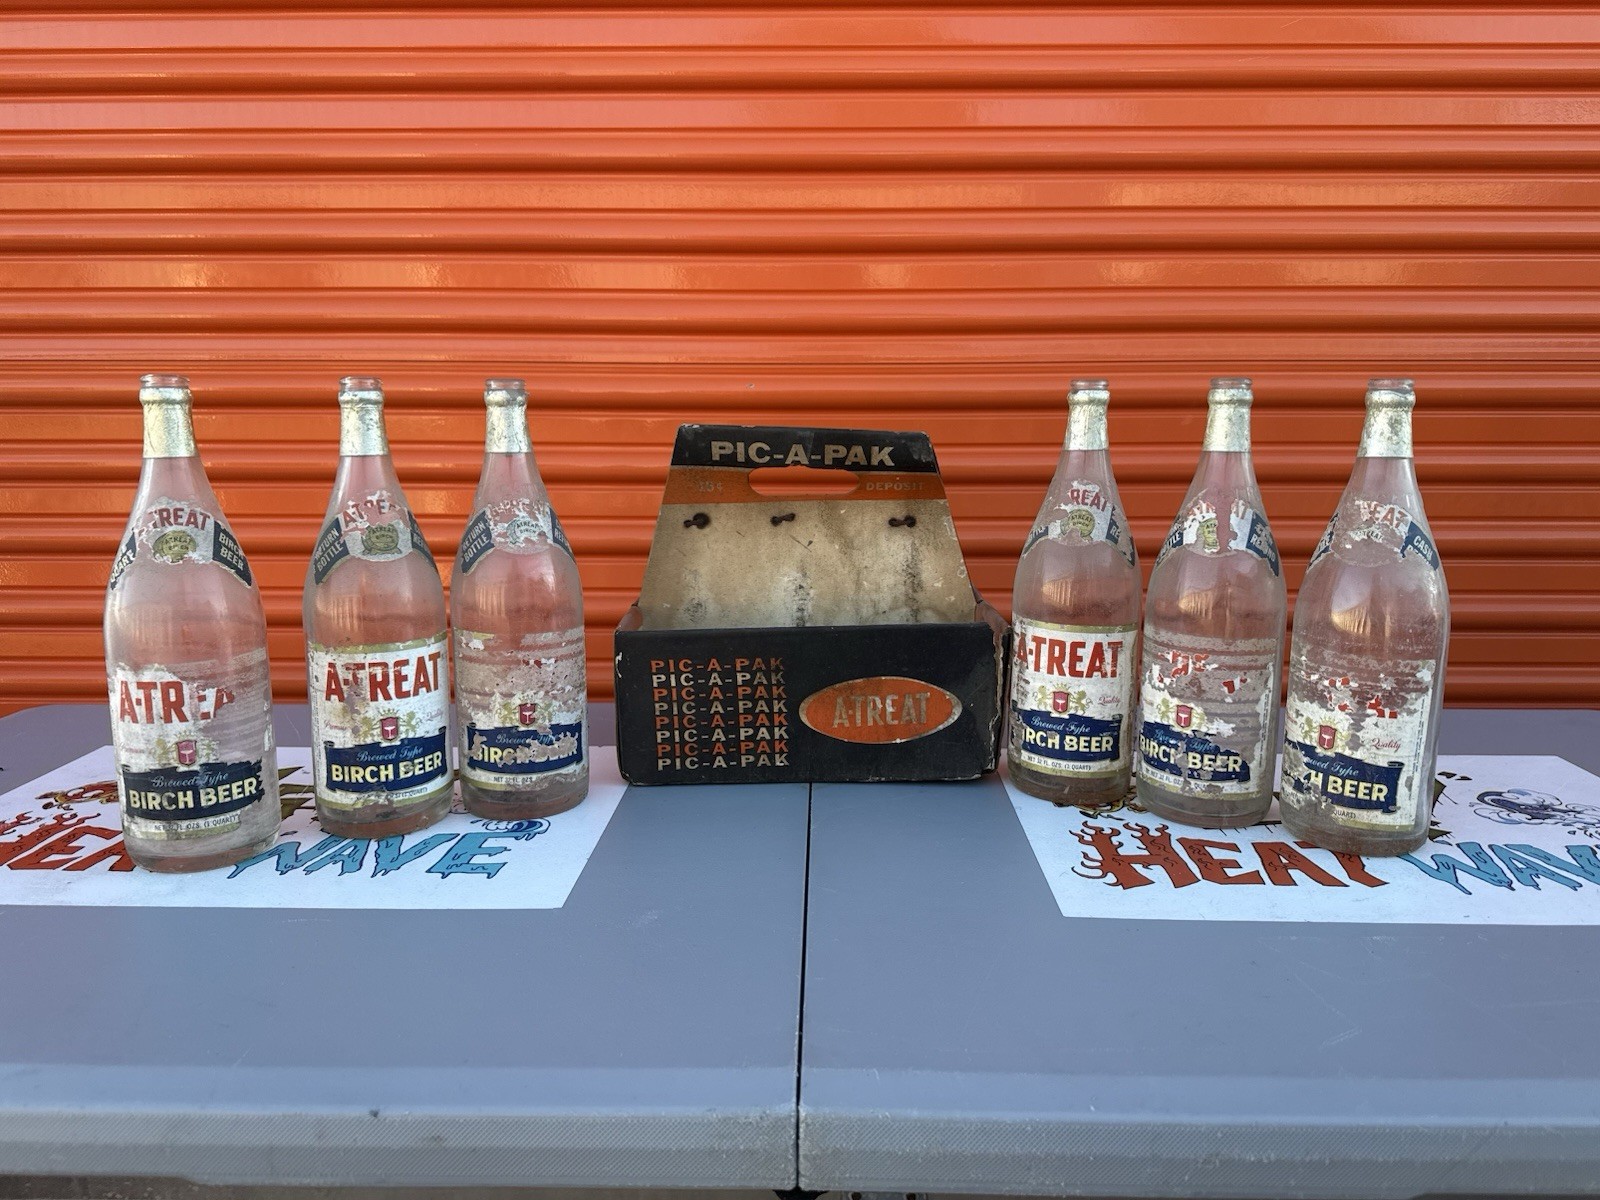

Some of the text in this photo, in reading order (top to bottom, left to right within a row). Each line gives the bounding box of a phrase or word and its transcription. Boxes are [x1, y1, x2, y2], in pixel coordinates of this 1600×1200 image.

[710, 440, 895, 467] PIC-A-PAK
[865, 481, 925, 491] DEPOSIT
[462, 520, 486, 551] RETURN
[463, 533, 490, 562] BOTTLE
[1413, 535, 1434, 560] CASH
[219, 545, 245, 571] BEER
[650, 658, 785, 672] PIC-A-PAK
[652, 671, 786, 687] PIC-A-PAK
[652, 686, 787, 701] PIC-A-PAK
[654, 700, 788, 715] PIC-A-PAK
[655, 714, 788, 729] PIC-A-PAK
[1030, 715, 1091, 735] Brewed Type
[656, 728, 789, 743] PIC-A-PAK
[1064, 734, 1114, 752] BEER
[356, 746, 424, 762] Brewed Type
[657, 742, 789, 757] PIC-A-PAK
[1372, 737, 1402, 753] Quality
[331, 751, 443, 784] BIRCH BEER
[657, 753, 789, 771] PIC-A-PAK
[1188, 751, 1242, 772] BEER
[1331, 760, 1360, 777] Type
[151, 771, 229, 788] Brewed Type
[1327, 775, 1389, 802] BEER
[128, 777, 257, 811] BIRCH BEER
[1396, 841, 1600, 896] WAV
